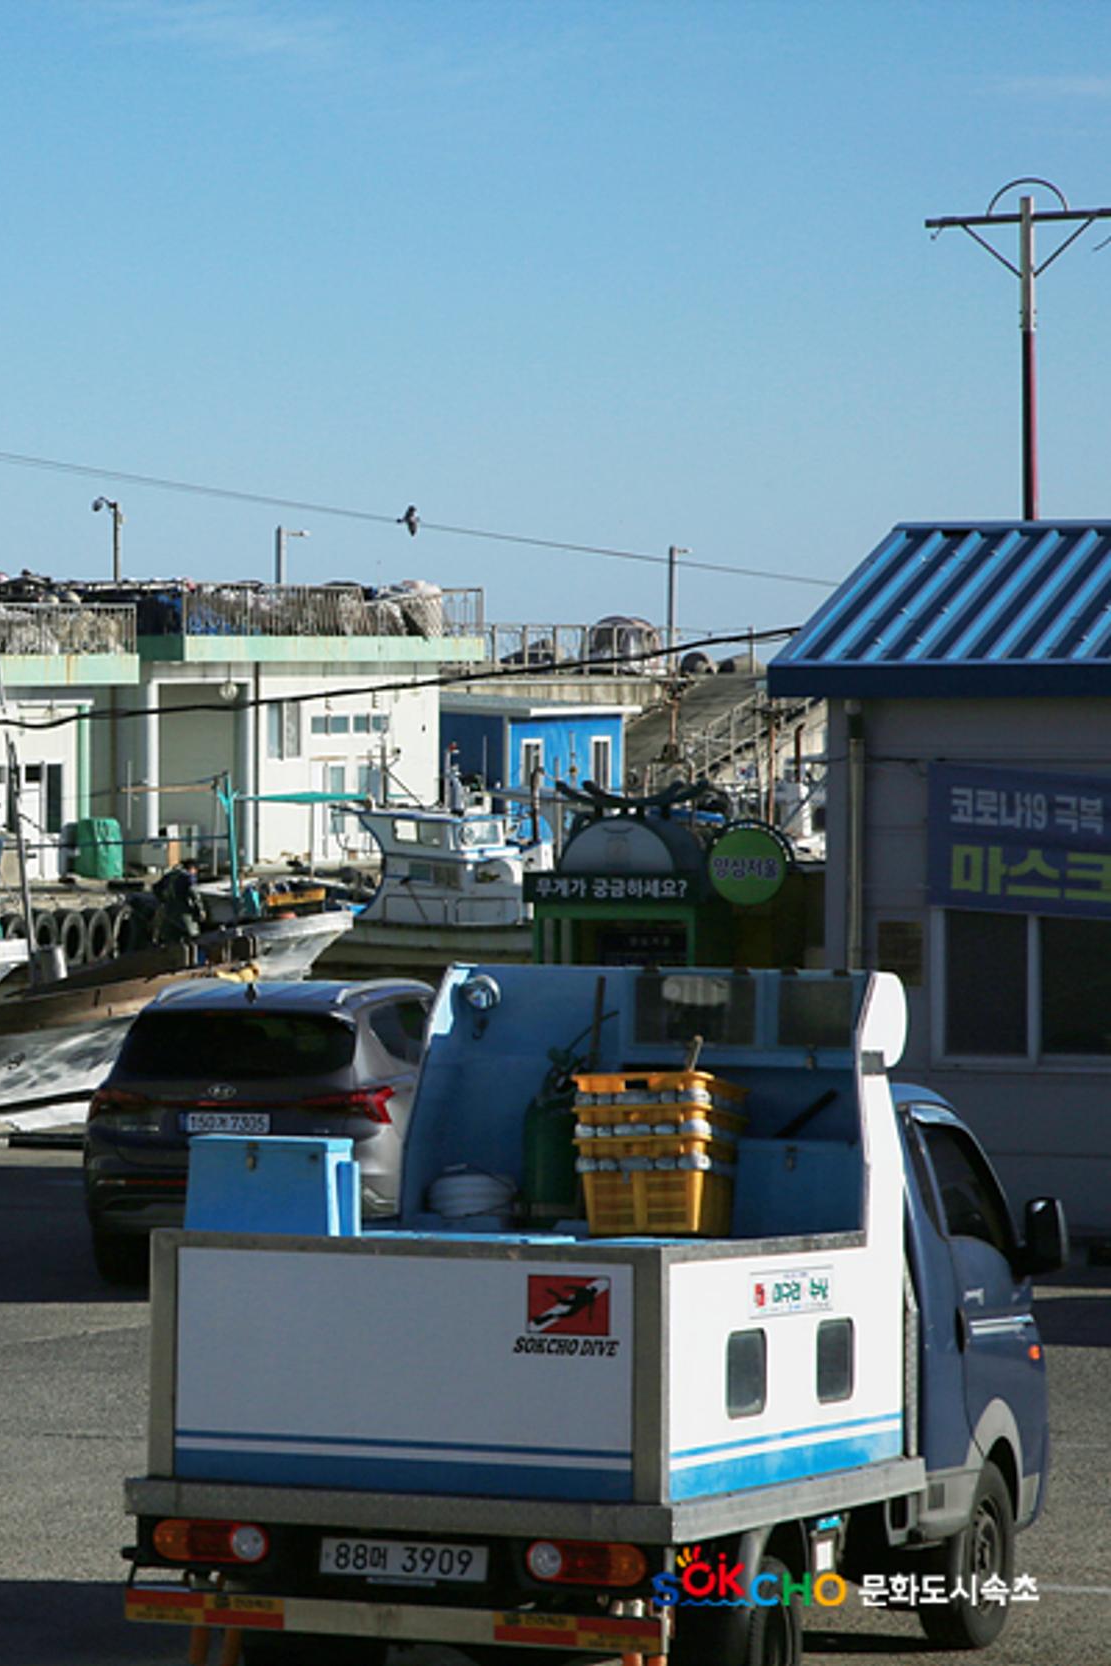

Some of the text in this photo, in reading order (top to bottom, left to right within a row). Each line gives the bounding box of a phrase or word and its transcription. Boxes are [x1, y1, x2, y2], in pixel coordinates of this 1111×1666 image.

[950, 786, 1105, 835] 코로나19 극복
[712, 856, 780, 881] 양심저울
[950, 843, 1111, 903] 마스크
[536, 877, 688, 899] 무게가 궁금하세요?
[513, 1336, 620, 1357] SOKCHO DIVE
[334, 1542, 474, 1576] 88머 3909
